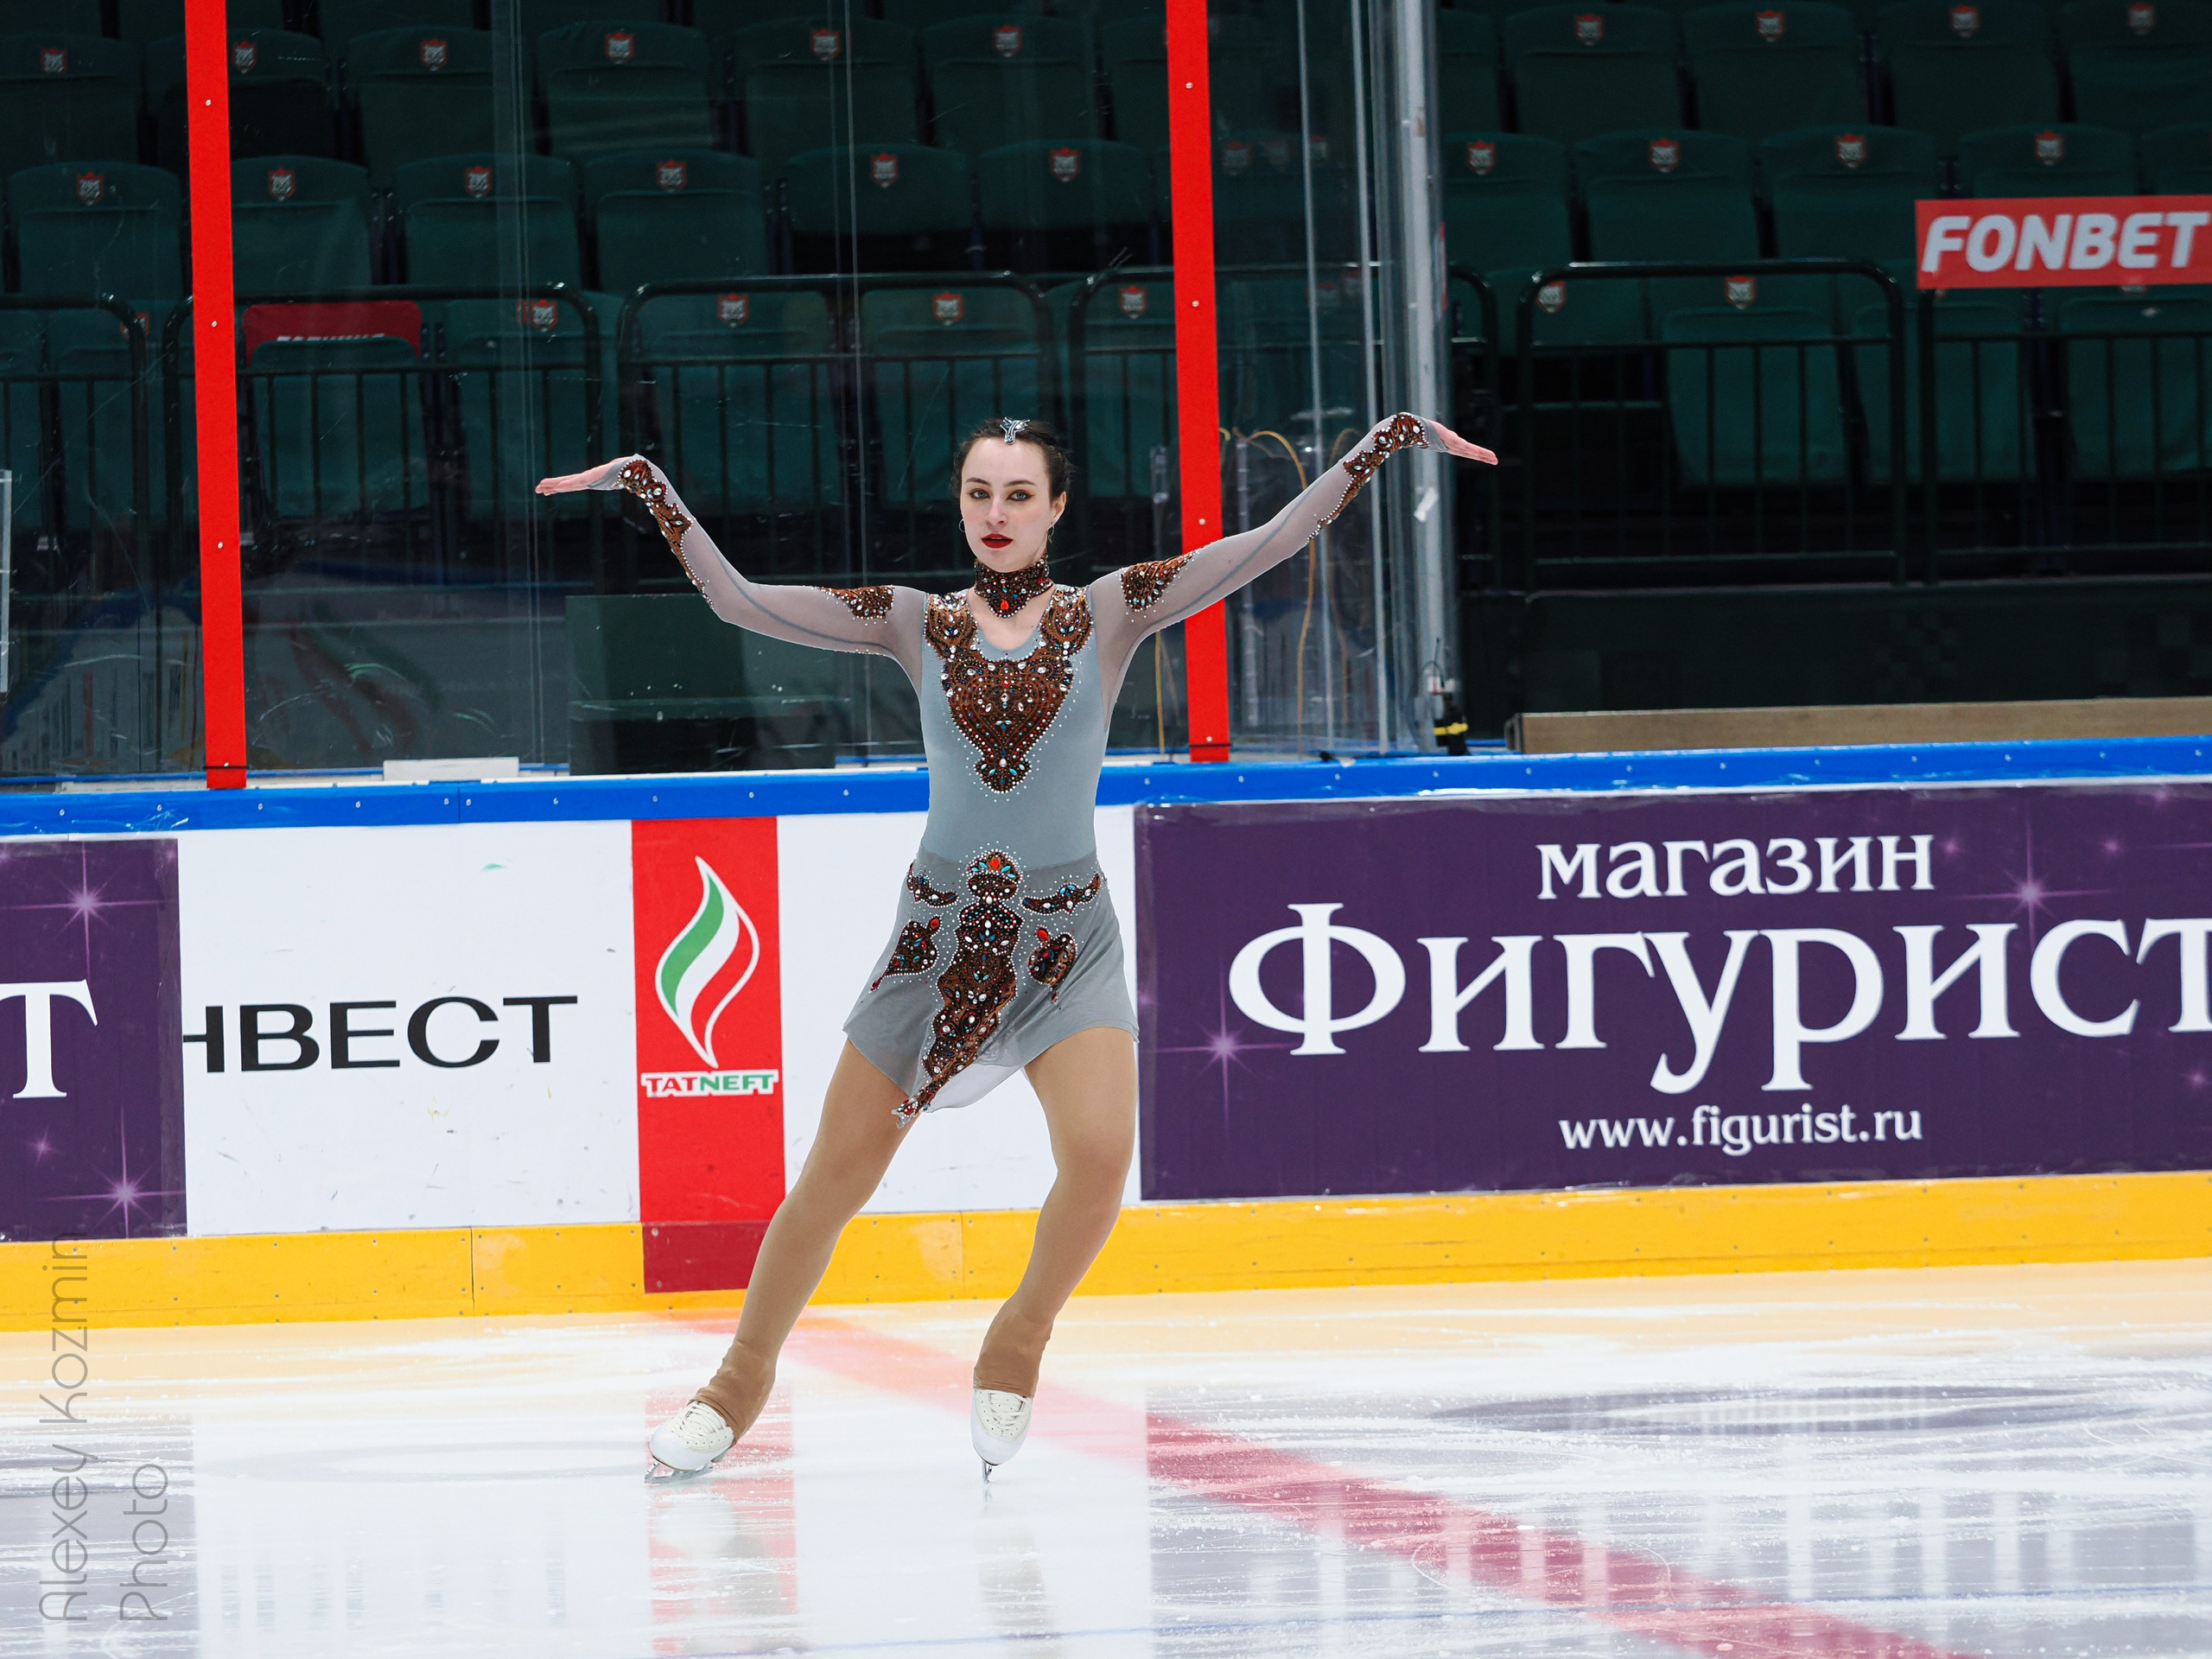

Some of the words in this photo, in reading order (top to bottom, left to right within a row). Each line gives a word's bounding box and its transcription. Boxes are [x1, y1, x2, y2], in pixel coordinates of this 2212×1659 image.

[1921, 213, 2210, 272] FONBET
[1535, 834, 1935, 900] магазин
[645, 1074, 774, 1092] TATNEFT
[1559, 1103, 1923, 1156] www.figurist.ru
